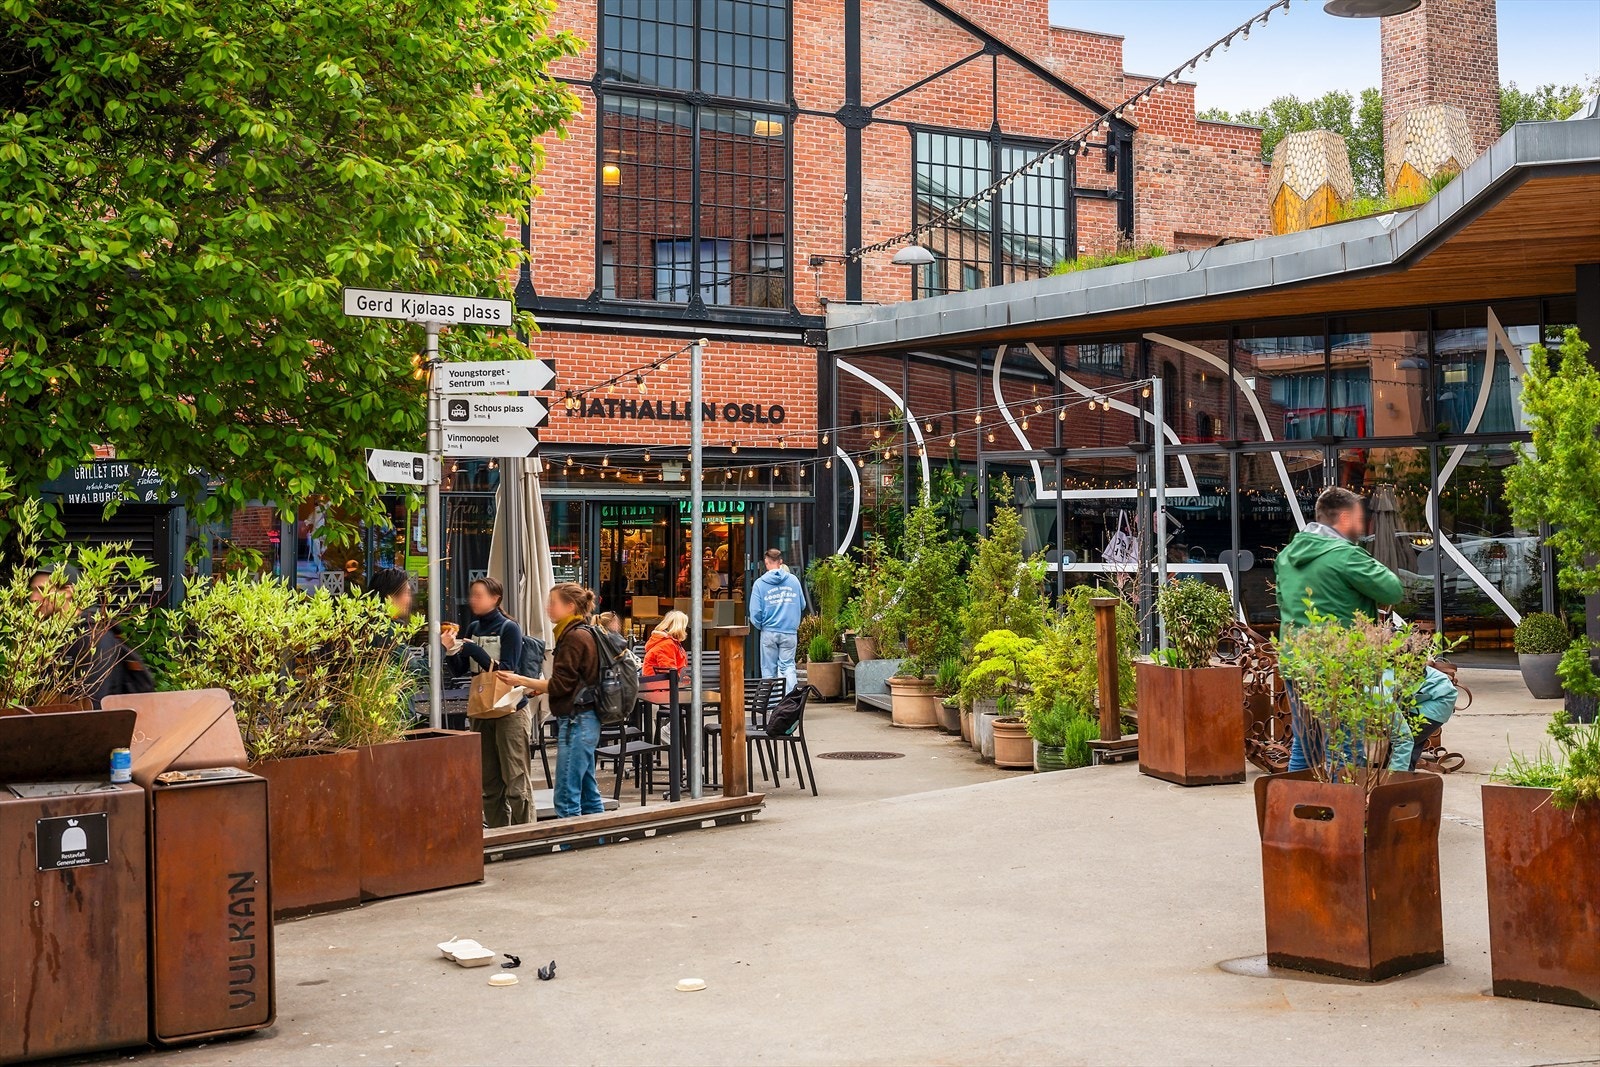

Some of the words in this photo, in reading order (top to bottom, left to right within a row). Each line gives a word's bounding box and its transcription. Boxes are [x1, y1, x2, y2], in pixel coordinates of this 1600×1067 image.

[357, 295, 392, 312] Gerd
[401, 299, 455, 317] Kjølaas
[463, 304, 500, 320] plass
[448, 369, 505, 378] Youngstorget
[448, 380, 485, 388] Sentrum
[474, 404, 502, 412] Schous
[503, 404, 524, 413] plass
[723, 402, 786, 424] OSLO
[447, 434, 500, 443] Vinmonopolet
[74, 464, 108, 480] GRILLET
[110, 464, 130, 478] FISK
[680, 500, 745, 513] PADIS
[61, 851, 86, 860] Restavfall
[56, 858, 76, 867] General
[227, 871, 257, 1010] VULKAN
